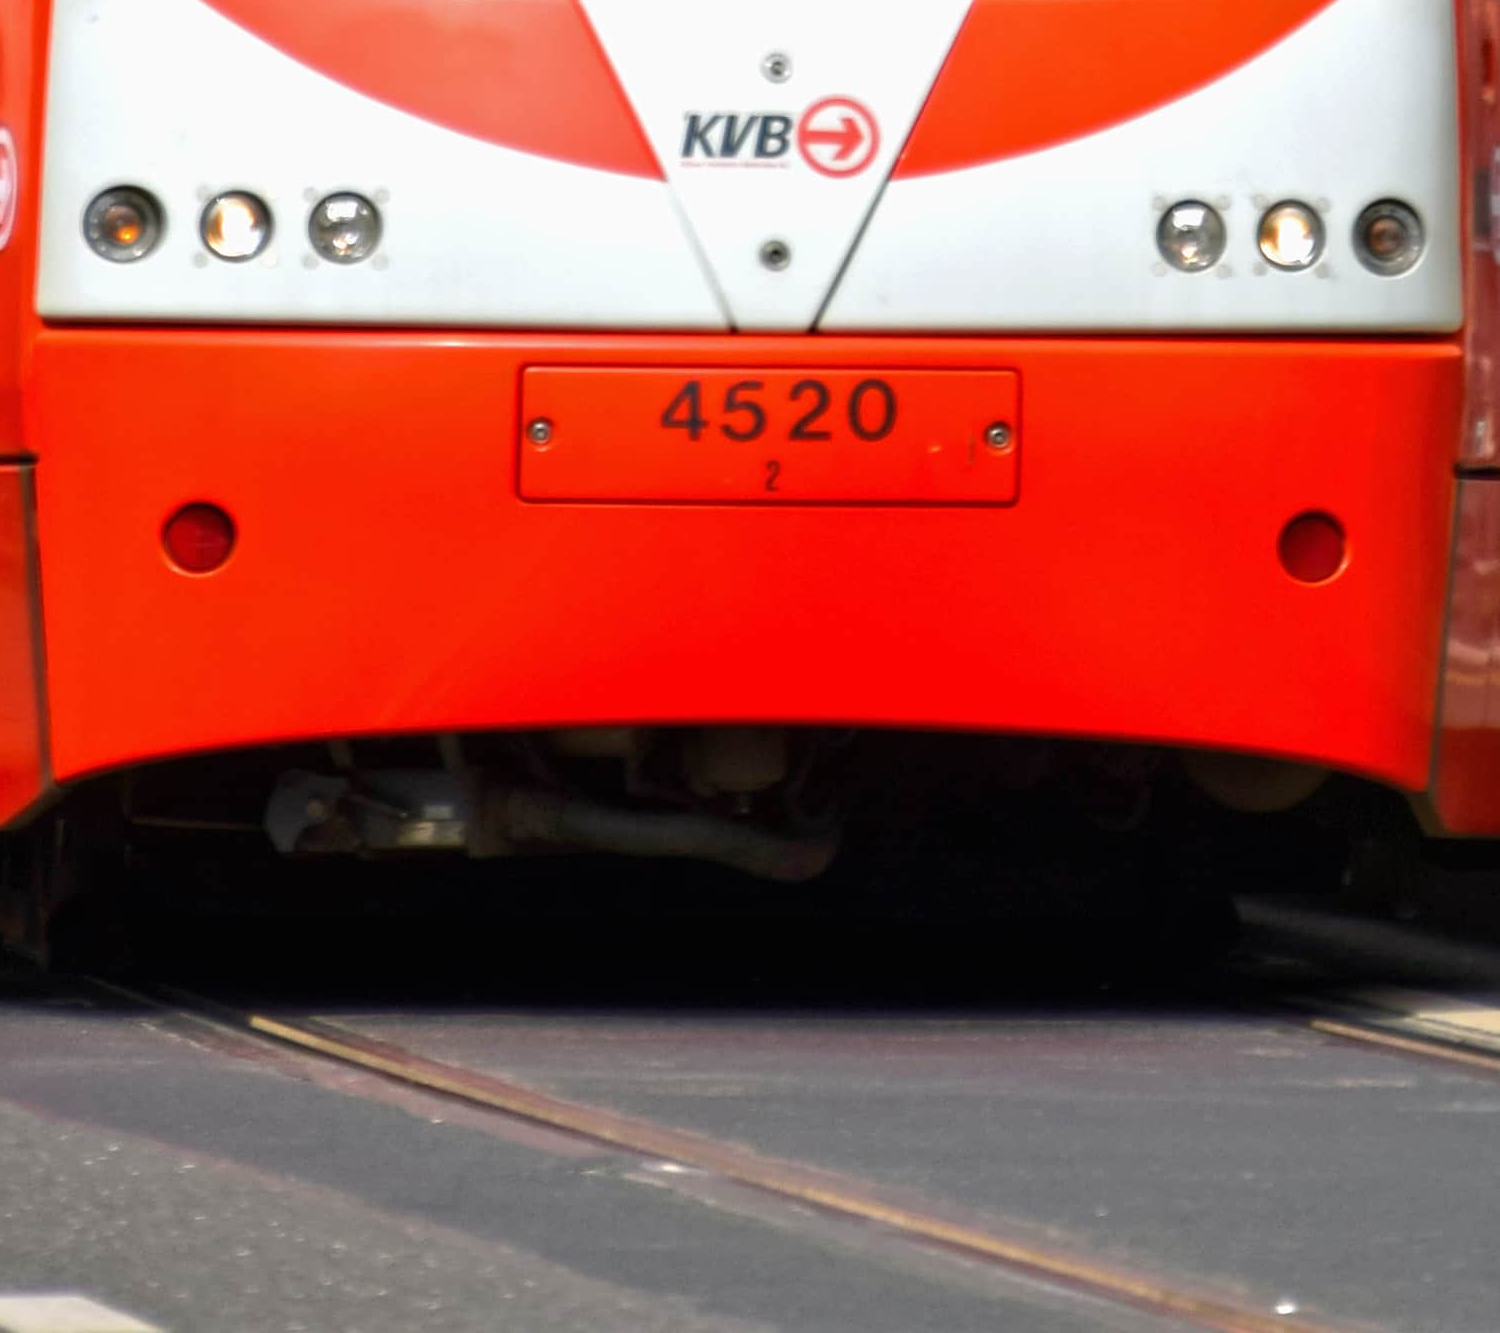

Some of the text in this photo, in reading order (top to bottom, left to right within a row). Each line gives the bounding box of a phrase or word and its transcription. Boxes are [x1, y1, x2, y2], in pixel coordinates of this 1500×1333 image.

[680, 113, 793, 159] KVB
[659, 378, 897, 442] 4520
[764, 458, 781, 492] 2
